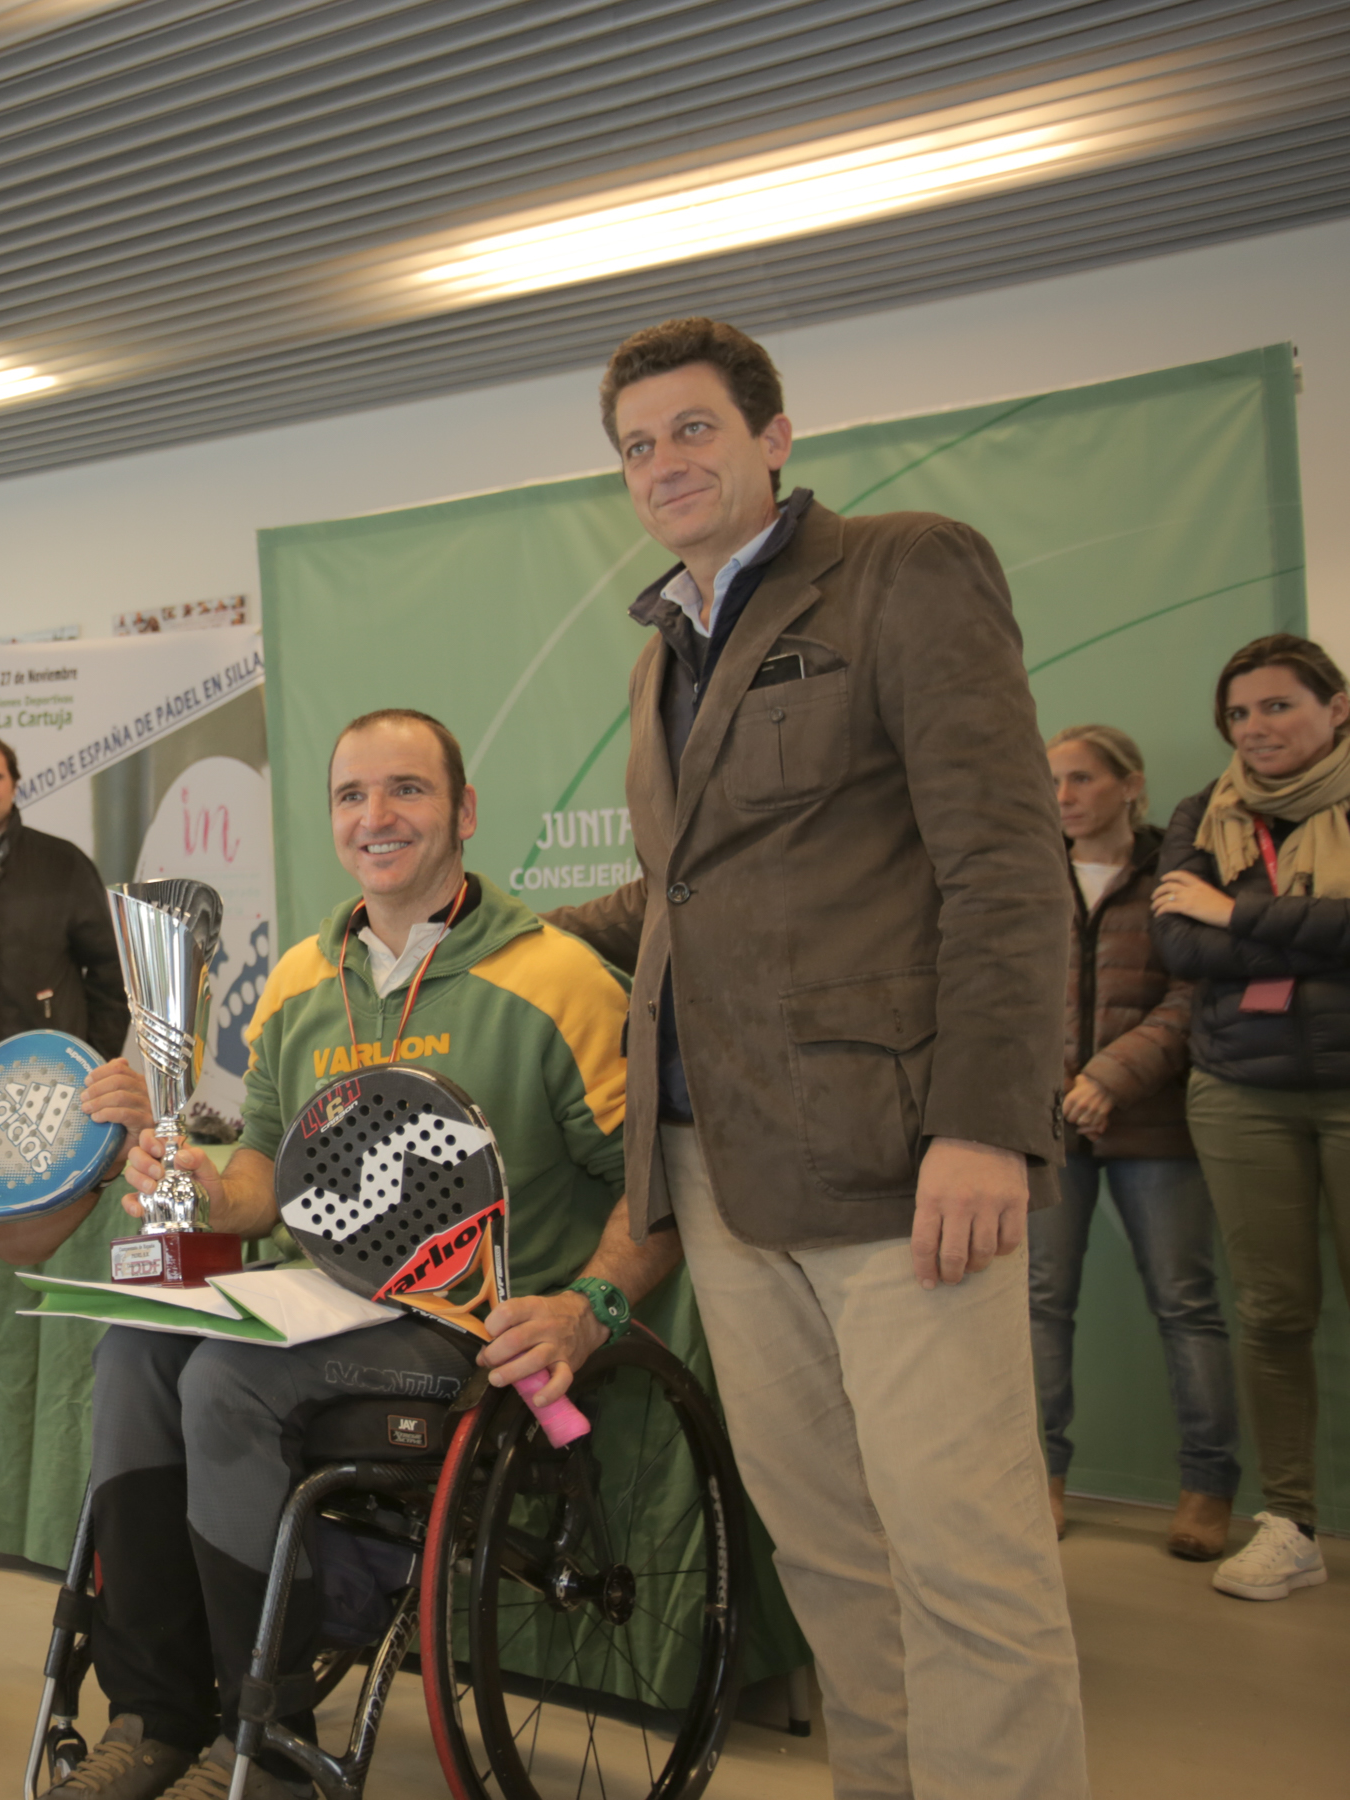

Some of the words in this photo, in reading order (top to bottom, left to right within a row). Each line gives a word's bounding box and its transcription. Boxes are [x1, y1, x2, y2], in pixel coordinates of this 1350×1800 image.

[0, 671, 11, 686] 27
[14, 671, 25, 685] de
[27, 667, 77, 683] Noviembre
[17, 708, 72, 731] Cartuja
[58, 756, 77, 781] DE
[79, 724, 133, 770] ESPAÑA
[134, 713, 154, 740] DE
[155, 687, 202, 727] PÁDEL
[202, 671, 224, 699] EN
[224, 651, 265, 690] SILLA
[313, 1033, 450, 1078] VARLION
[398, 1418, 418, 1431] JAY
